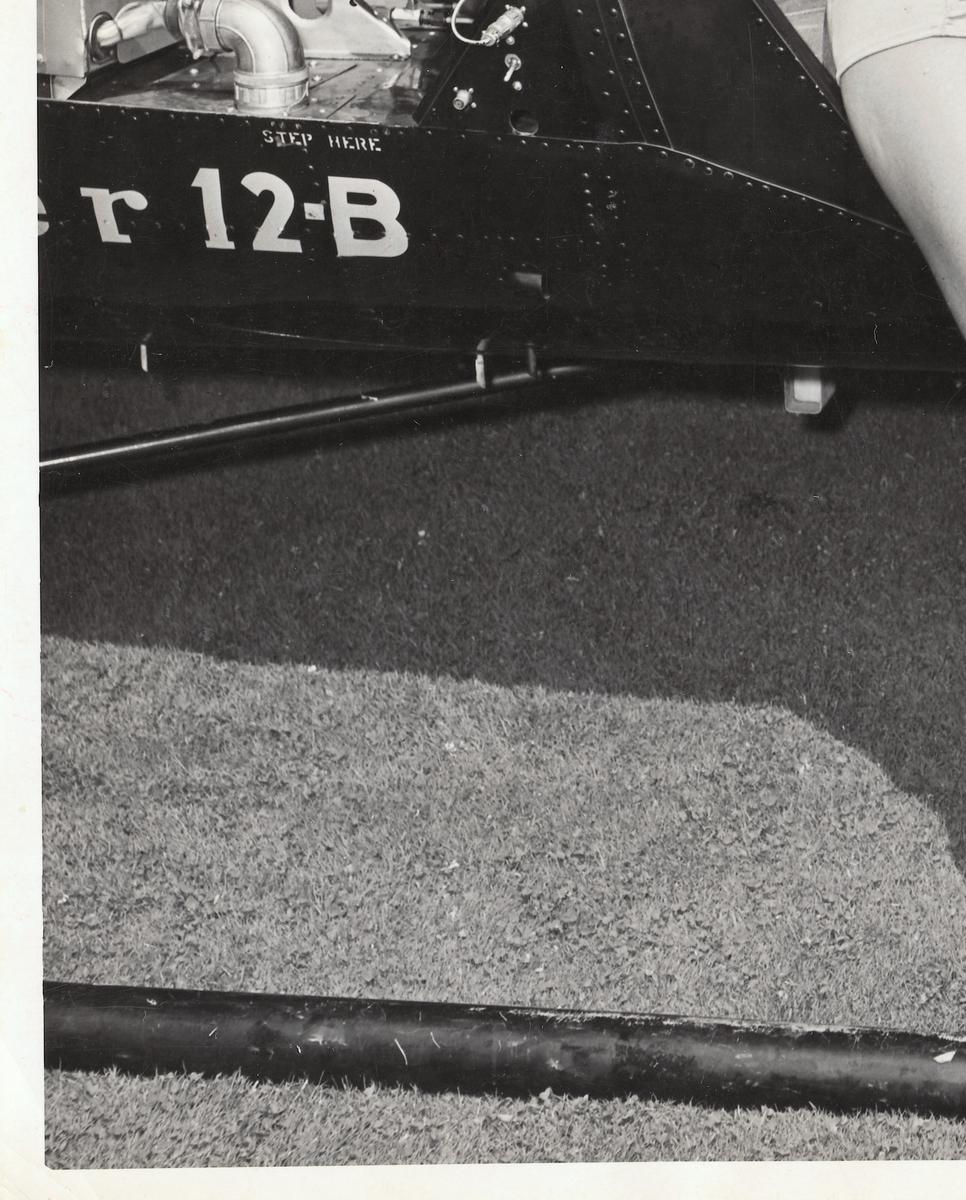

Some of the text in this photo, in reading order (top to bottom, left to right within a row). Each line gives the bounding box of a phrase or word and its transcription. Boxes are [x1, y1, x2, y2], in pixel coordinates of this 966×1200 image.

[262, 130, 381, 151] STEP HERE
[191, 168, 409, 257] 12-B
